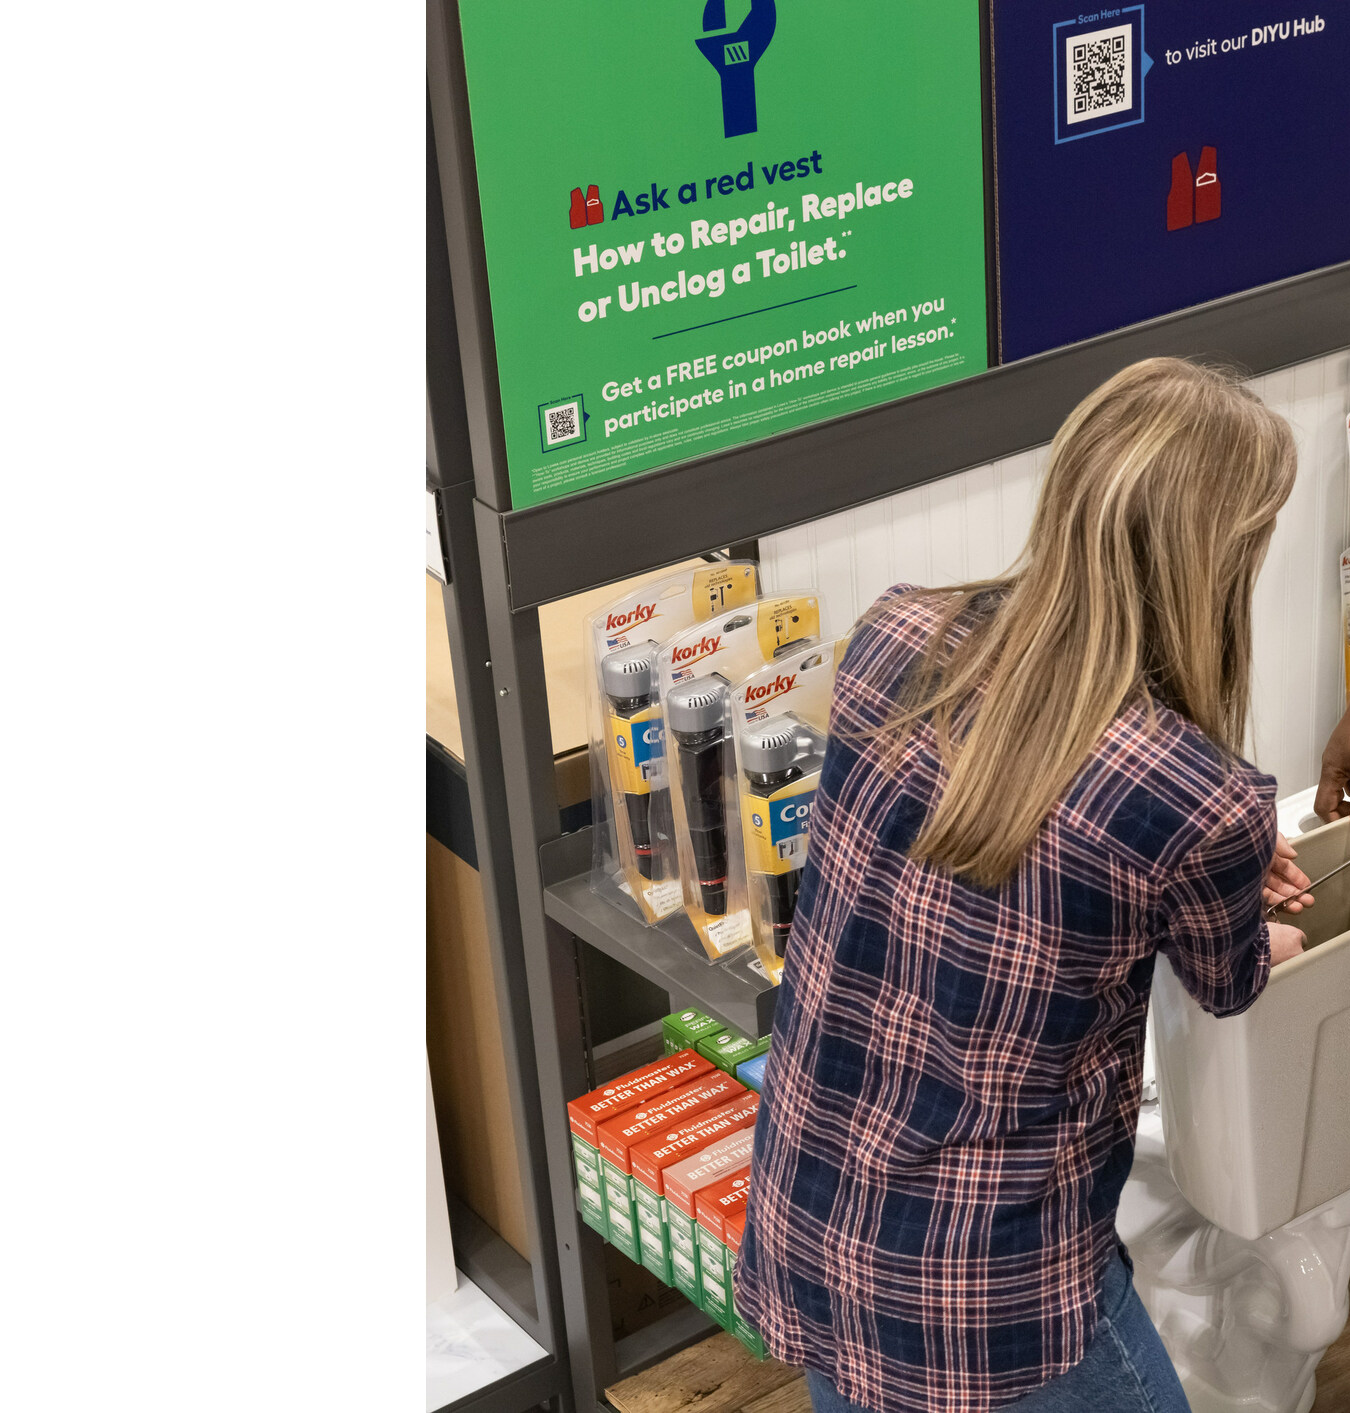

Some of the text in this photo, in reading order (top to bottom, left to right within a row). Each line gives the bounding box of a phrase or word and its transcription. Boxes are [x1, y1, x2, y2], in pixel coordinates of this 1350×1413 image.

[1078, 8, 1121, 25] Scan Here
[1165, 15, 1325, 65] to visit our DIYU Hub
[611, 149, 823, 220] Ask a red vest
[573, 177, 914, 277] How to Repair, Replace
[577, 295, 612, 323] or
[618, 266, 726, 312] Unclog
[731, 261, 751, 285] a
[601, 297, 945, 402] Get a FREE coupon book when you
[603, 383, 725, 438] participate
[728, 378, 747, 399] in
[751, 376, 765, 393] a
[769, 359, 826, 388] home
[829, 339, 887, 382] repair
[709, 574, 728, 583] REPLACES
[606, 603, 657, 630] korky
[620, 641, 631, 649] USA
[671, 635, 721, 664] korky
[684, 674, 695, 682] USA
[745, 673, 797, 703] korky
[758, 713, 770, 721] USA
[689, 1018, 716, 1031] WAX
[590, 1060, 697, 1112] BETTER THAN WAX
[615, 1064, 674, 1092] Fluidmaster
[622, 1082, 729, 1137] BETTER THAN WAX
[646, 1085, 705, 1114] Fluidmaster
[653, 1104, 759, 1158] BETTER THAN WAX
[678, 1107, 736, 1136] Fluidmaster
[712, 1134, 753, 1157] Fluidma
[687, 1156, 732, 1180] BETTER
[729, 1143, 754, 1160] THA
[719, 1184, 750, 1206] BETT
